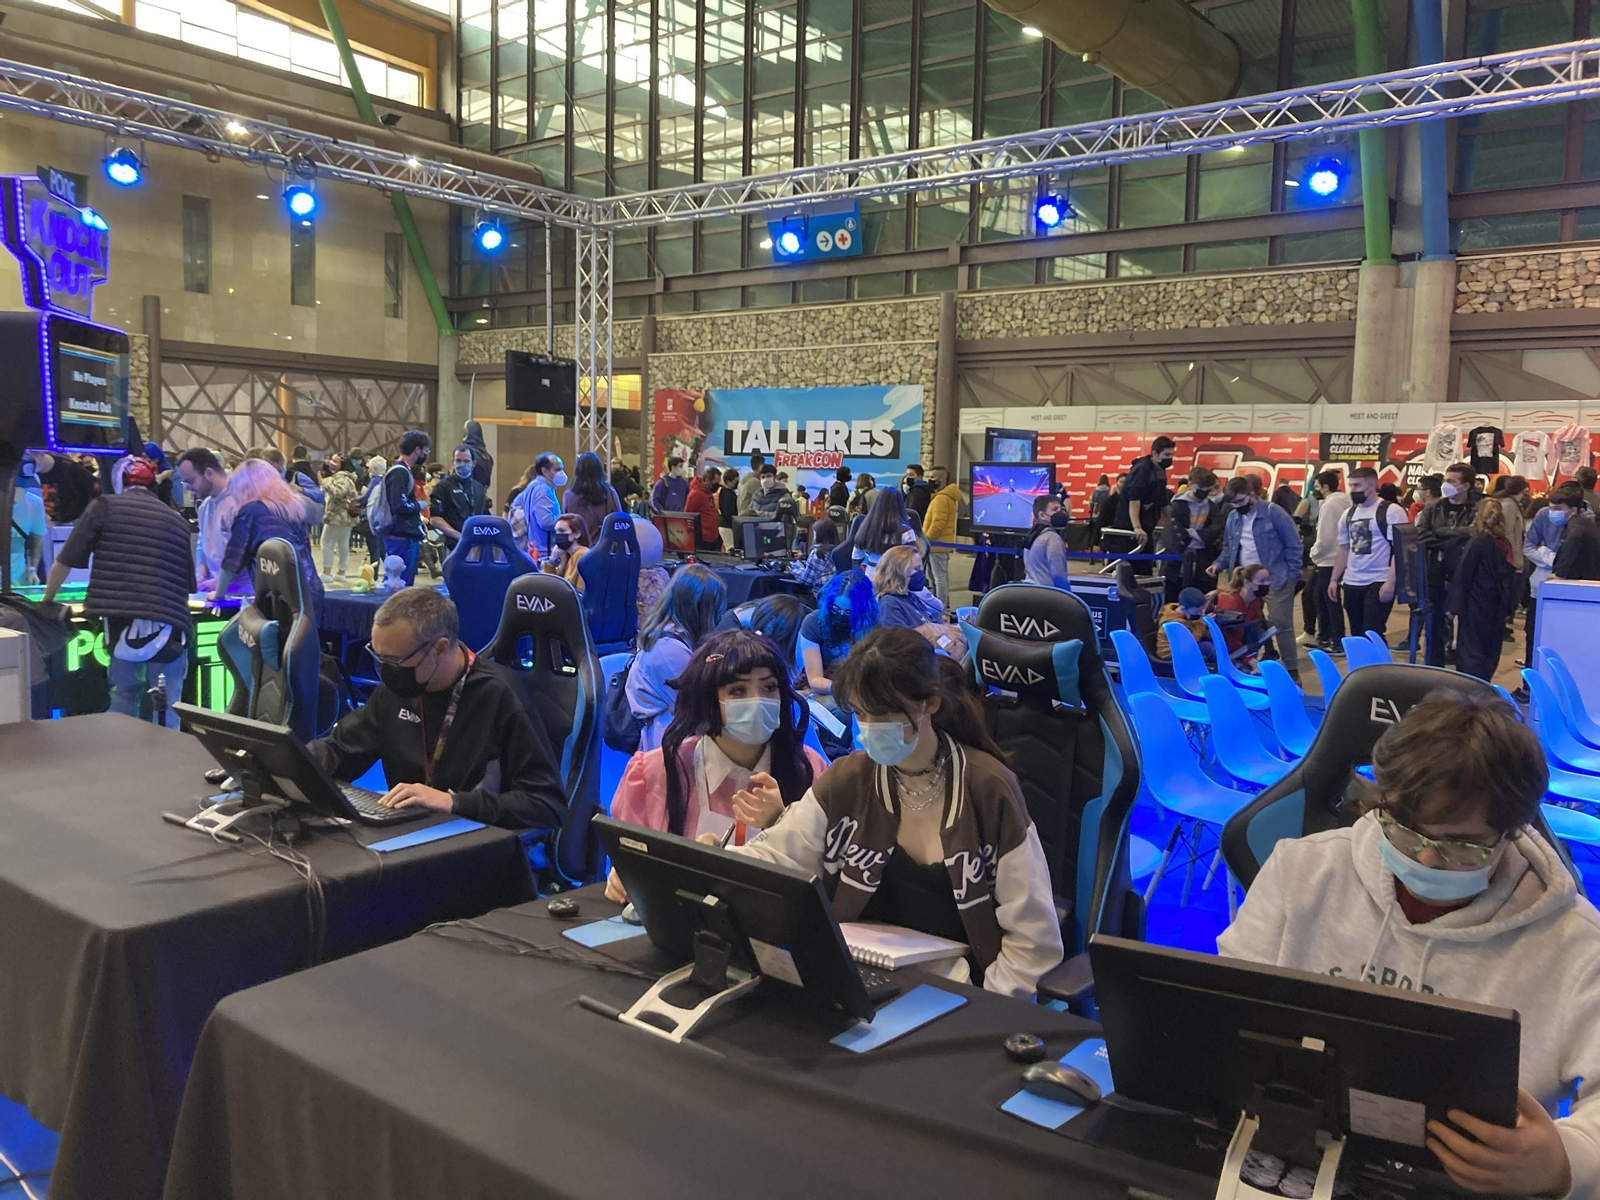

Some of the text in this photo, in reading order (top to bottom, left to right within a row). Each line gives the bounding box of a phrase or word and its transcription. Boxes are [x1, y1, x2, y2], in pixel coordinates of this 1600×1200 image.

[30, 198, 105, 270] KNOCK
[50, 250, 94, 301] OUT
[1349, 412, 1399, 420] MEET AND GREET
[727, 419, 895, 457] TALLERES
[1329, 445, 1369, 454] CLOTHING
[1330, 434, 1381, 445] NAKAMAS
[826, 816, 886, 870] New
